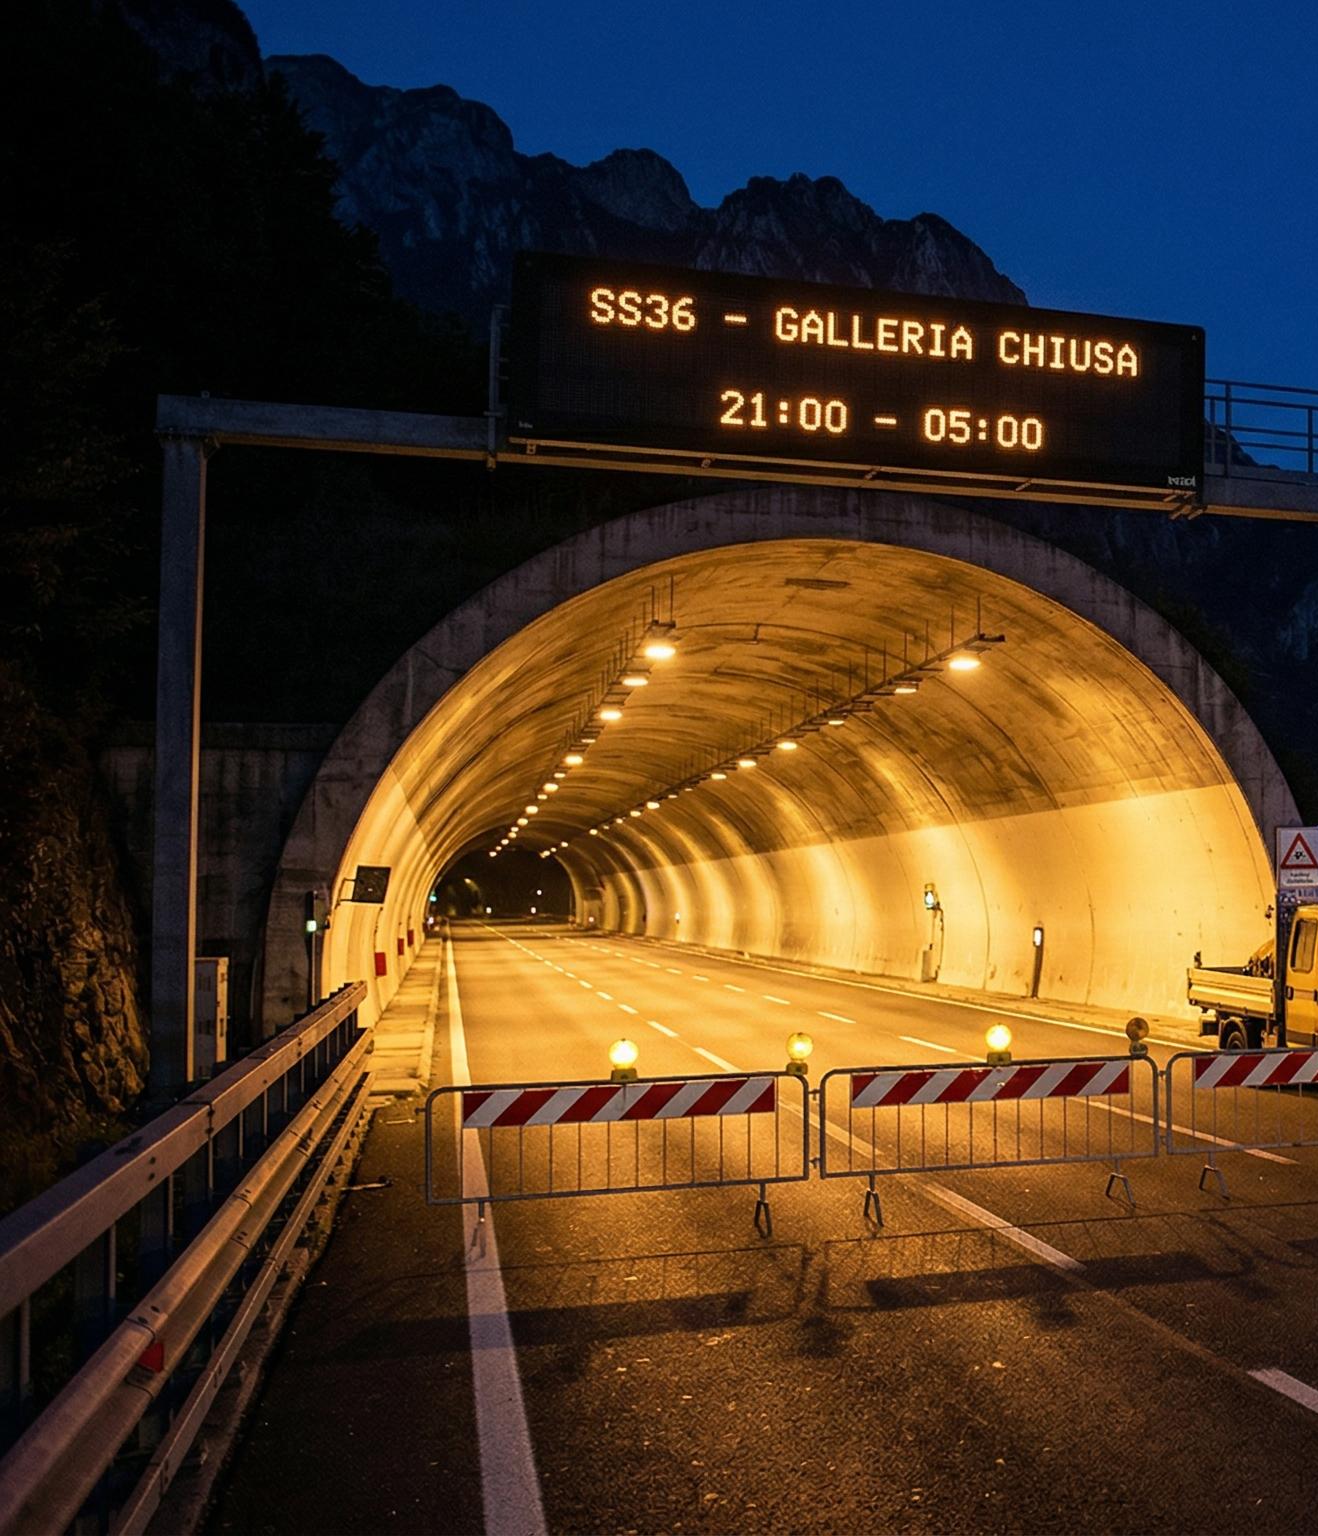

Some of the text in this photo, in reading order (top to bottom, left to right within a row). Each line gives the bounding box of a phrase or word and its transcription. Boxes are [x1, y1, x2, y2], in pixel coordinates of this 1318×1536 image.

[588, 286, 1140, 378] SS36 - GALLERIA CHIUSA
[718, 388, 1045, 454] 21:00 - 05:00
